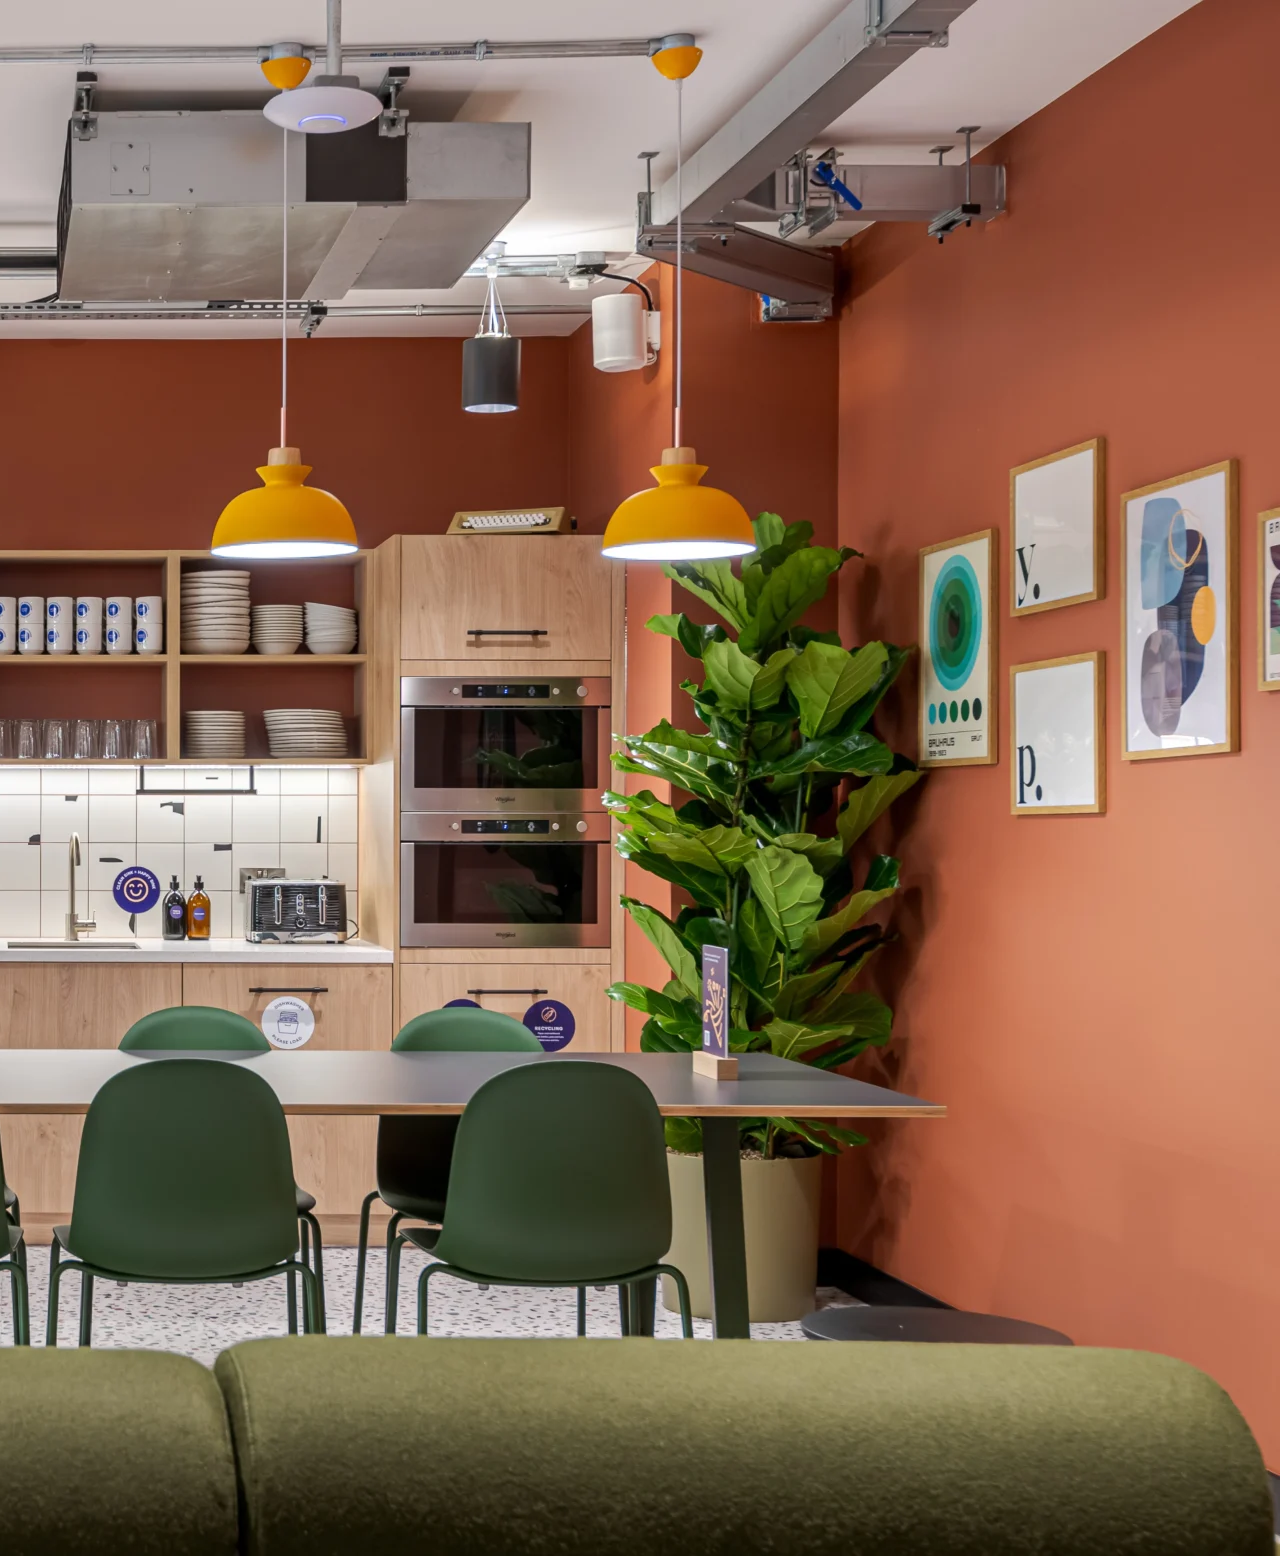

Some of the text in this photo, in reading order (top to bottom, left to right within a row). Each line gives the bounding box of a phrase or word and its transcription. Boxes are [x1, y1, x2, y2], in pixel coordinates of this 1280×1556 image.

[274, 1001, 305, 1011] DISHWASHER
[271, 1034, 303, 1044] PLEASE LOAD
